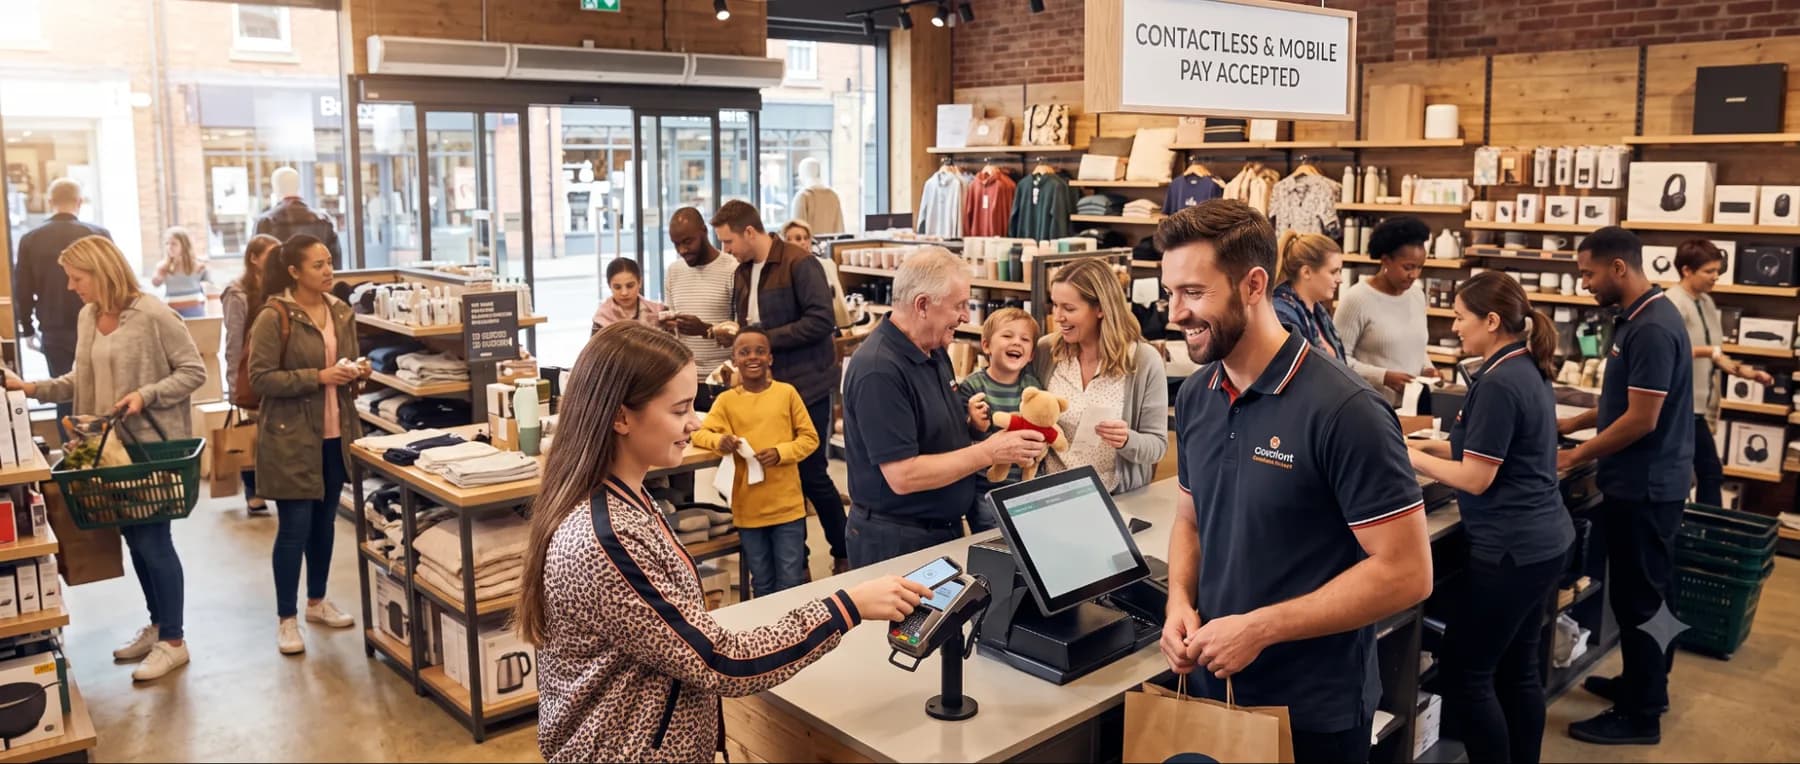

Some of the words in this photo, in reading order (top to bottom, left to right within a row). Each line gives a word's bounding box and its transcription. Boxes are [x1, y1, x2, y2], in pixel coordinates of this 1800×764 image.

[1135, 23, 1258, 55] CONTACTLESS
[1263, 36, 1275, 57] &
[1279, 38, 1337, 62] MOBILE
[1180, 59, 1212, 81] PAY
[1216, 62, 1300, 88] ACCEPTED
